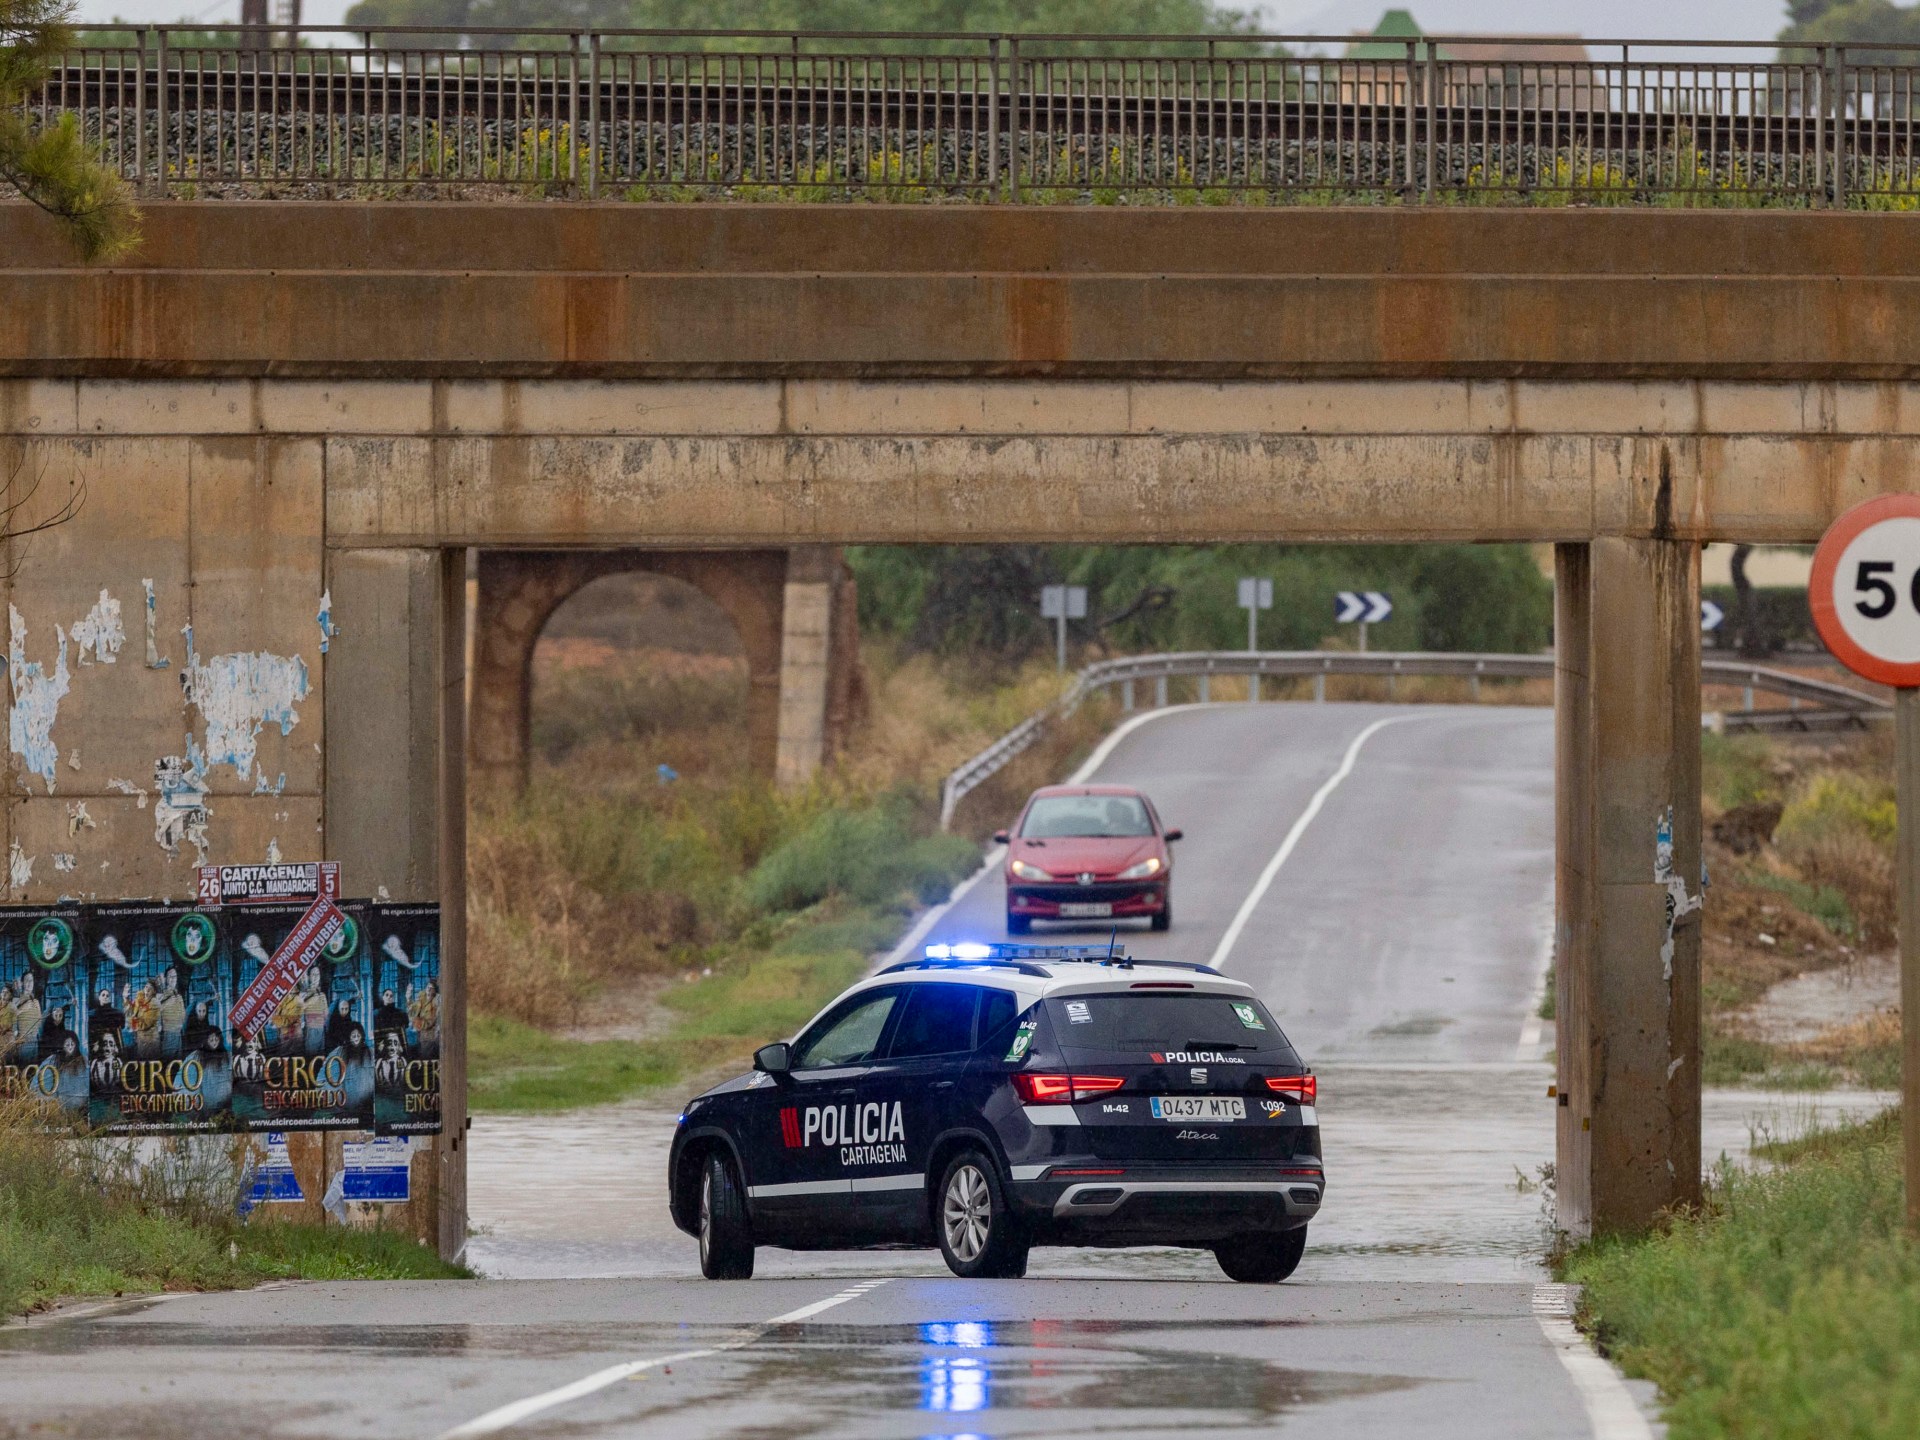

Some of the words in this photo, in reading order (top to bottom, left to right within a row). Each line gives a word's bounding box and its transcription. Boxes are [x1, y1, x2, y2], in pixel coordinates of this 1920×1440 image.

[1855, 561, 1920, 620] 5
[222, 865, 305, 881] CARTAGENA
[200, 878, 219, 897] 26
[222, 881, 247, 896] JUNTO
[248, 880, 265, 895] C.C.
[266, 879, 317, 894] MANDARACHE
[325, 874, 335, 893] 5
[245, 999, 276, 1036] HASTA
[272, 984, 288, 1002] EL
[281, 960, 303, 984] 12
[299, 914, 341, 967] OCTUBRE
[1019, 1021, 1038, 1030] M-42
[1166, 1052, 1225, 1063] POLICIA
[121, 1059, 204, 1092] CIRCO
[264, 1055, 347, 1089] CIRCO
[120, 1092, 204, 1114] ENCANTADO
[263, 1088, 347, 1110] ENCANTADO
[1103, 1104, 1129, 1113] M-42
[1162, 1100, 1204, 1116] 0437
[1210, 1100, 1242, 1116] MTC
[1266, 1100, 1287, 1112] 092
[249, 1117, 360, 1127] www.elcircoencantado.com
[804, 1101, 905, 1147] POLICIA
[1176, 1129, 1219, 1140] Ateca
[840, 1145, 907, 1166] CARTAGENA
